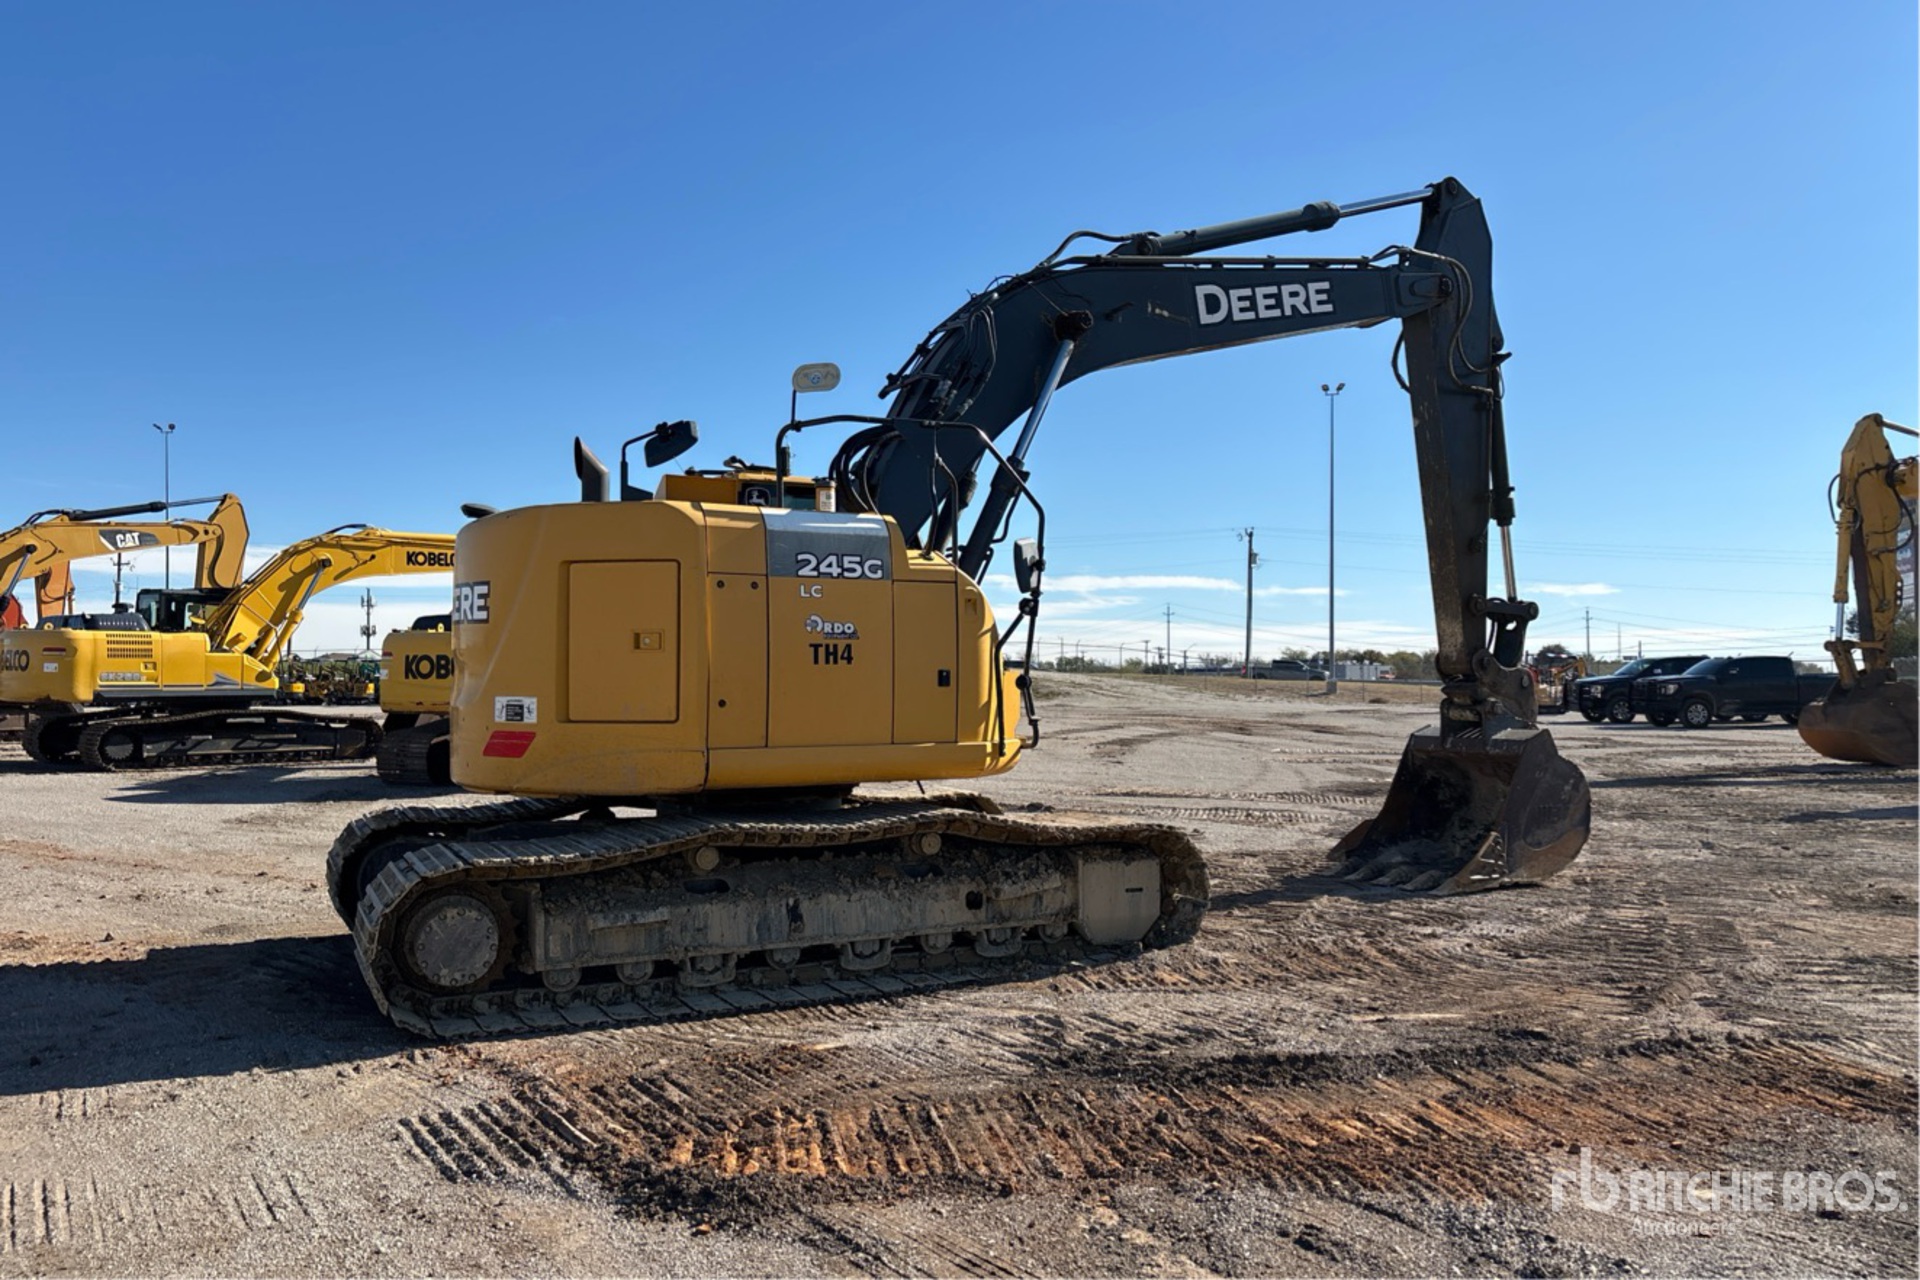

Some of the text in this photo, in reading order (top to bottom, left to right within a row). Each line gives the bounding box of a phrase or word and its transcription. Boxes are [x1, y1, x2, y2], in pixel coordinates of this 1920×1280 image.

[1195, 281, 1334, 325] DEERE
[115, 532, 140, 548] CAT
[797, 552, 883, 579] 245G
[800, 584, 823, 598] LC
[809, 643, 854, 665] TH4
[404, 654, 455, 680] KOB
